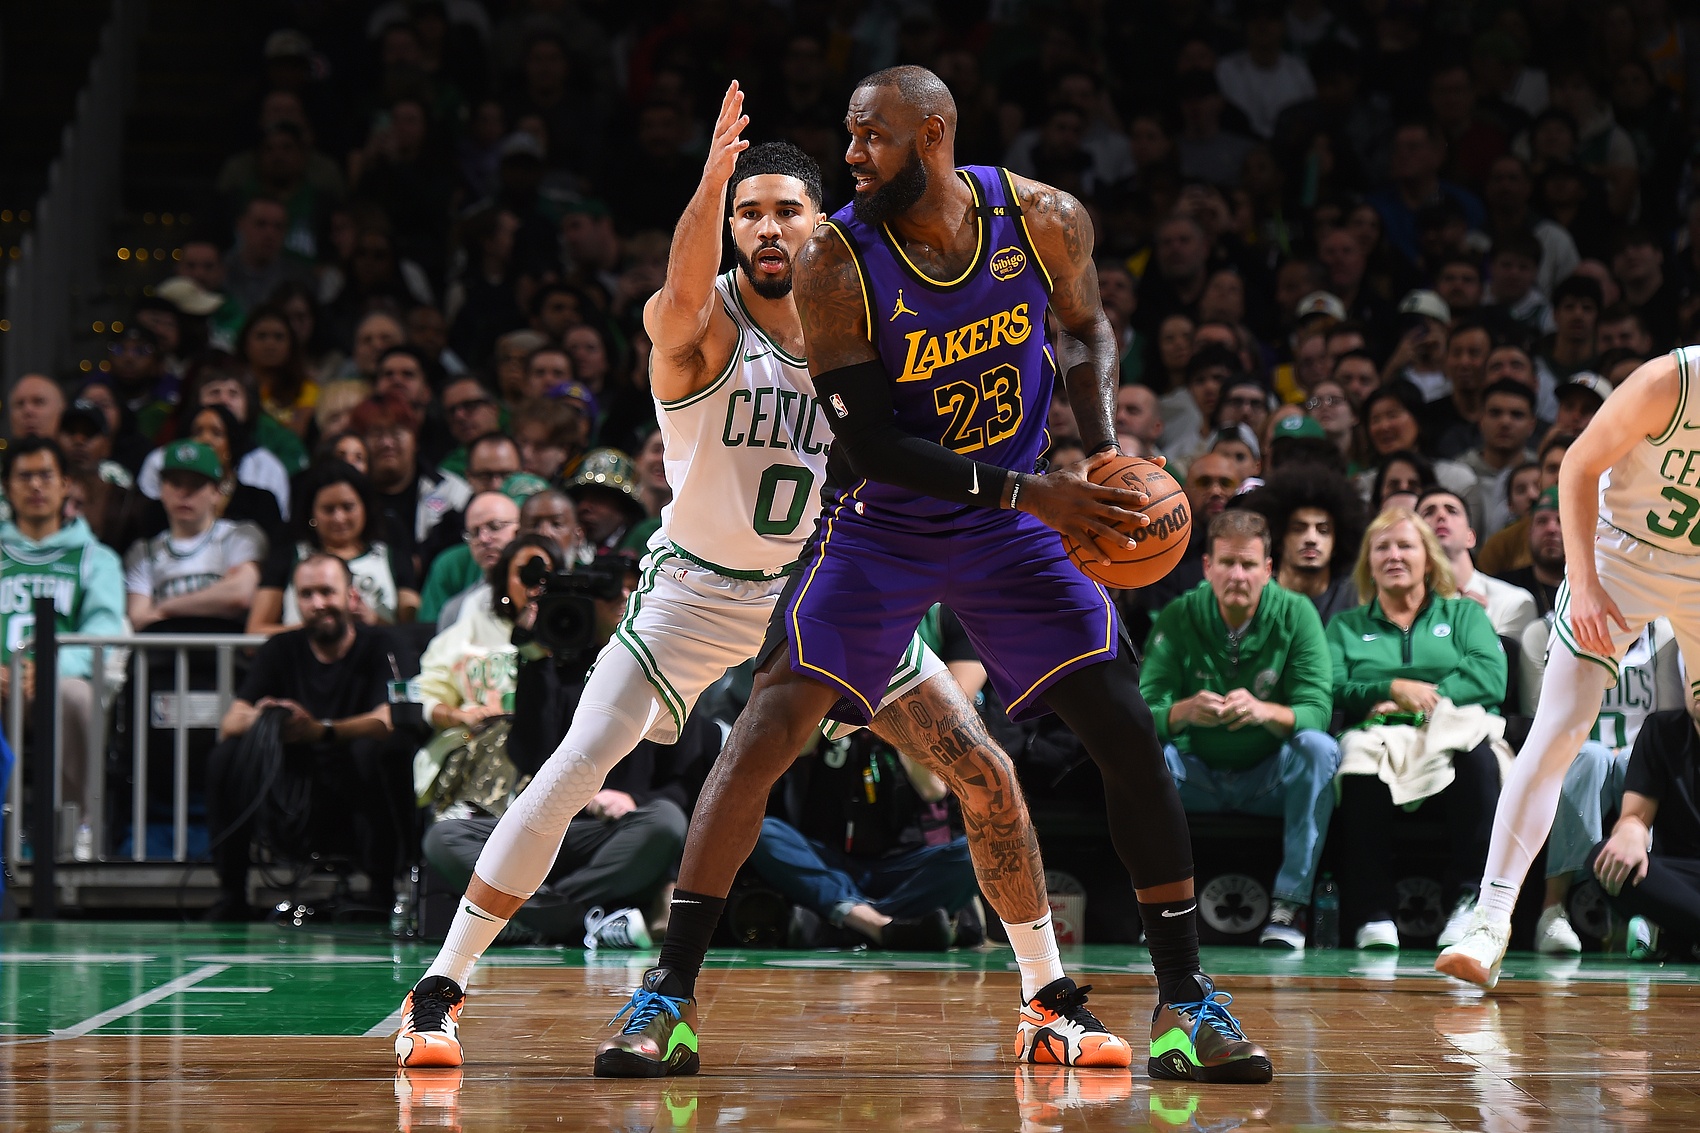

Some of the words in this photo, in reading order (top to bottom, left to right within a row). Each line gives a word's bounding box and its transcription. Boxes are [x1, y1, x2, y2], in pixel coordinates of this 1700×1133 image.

[993, 207, 1005, 216] 44
[993, 254, 1024, 272] bibigo
[896, 303, 1032, 383] LAKERS
[722, 387, 831, 457] CELTIC
[934, 363, 1024, 455] 23
[753, 464, 816, 536] 0
[1124, 503, 1189, 542] Wilso
[908, 700, 933, 729] 0
[995, 851, 1020, 872] 22
